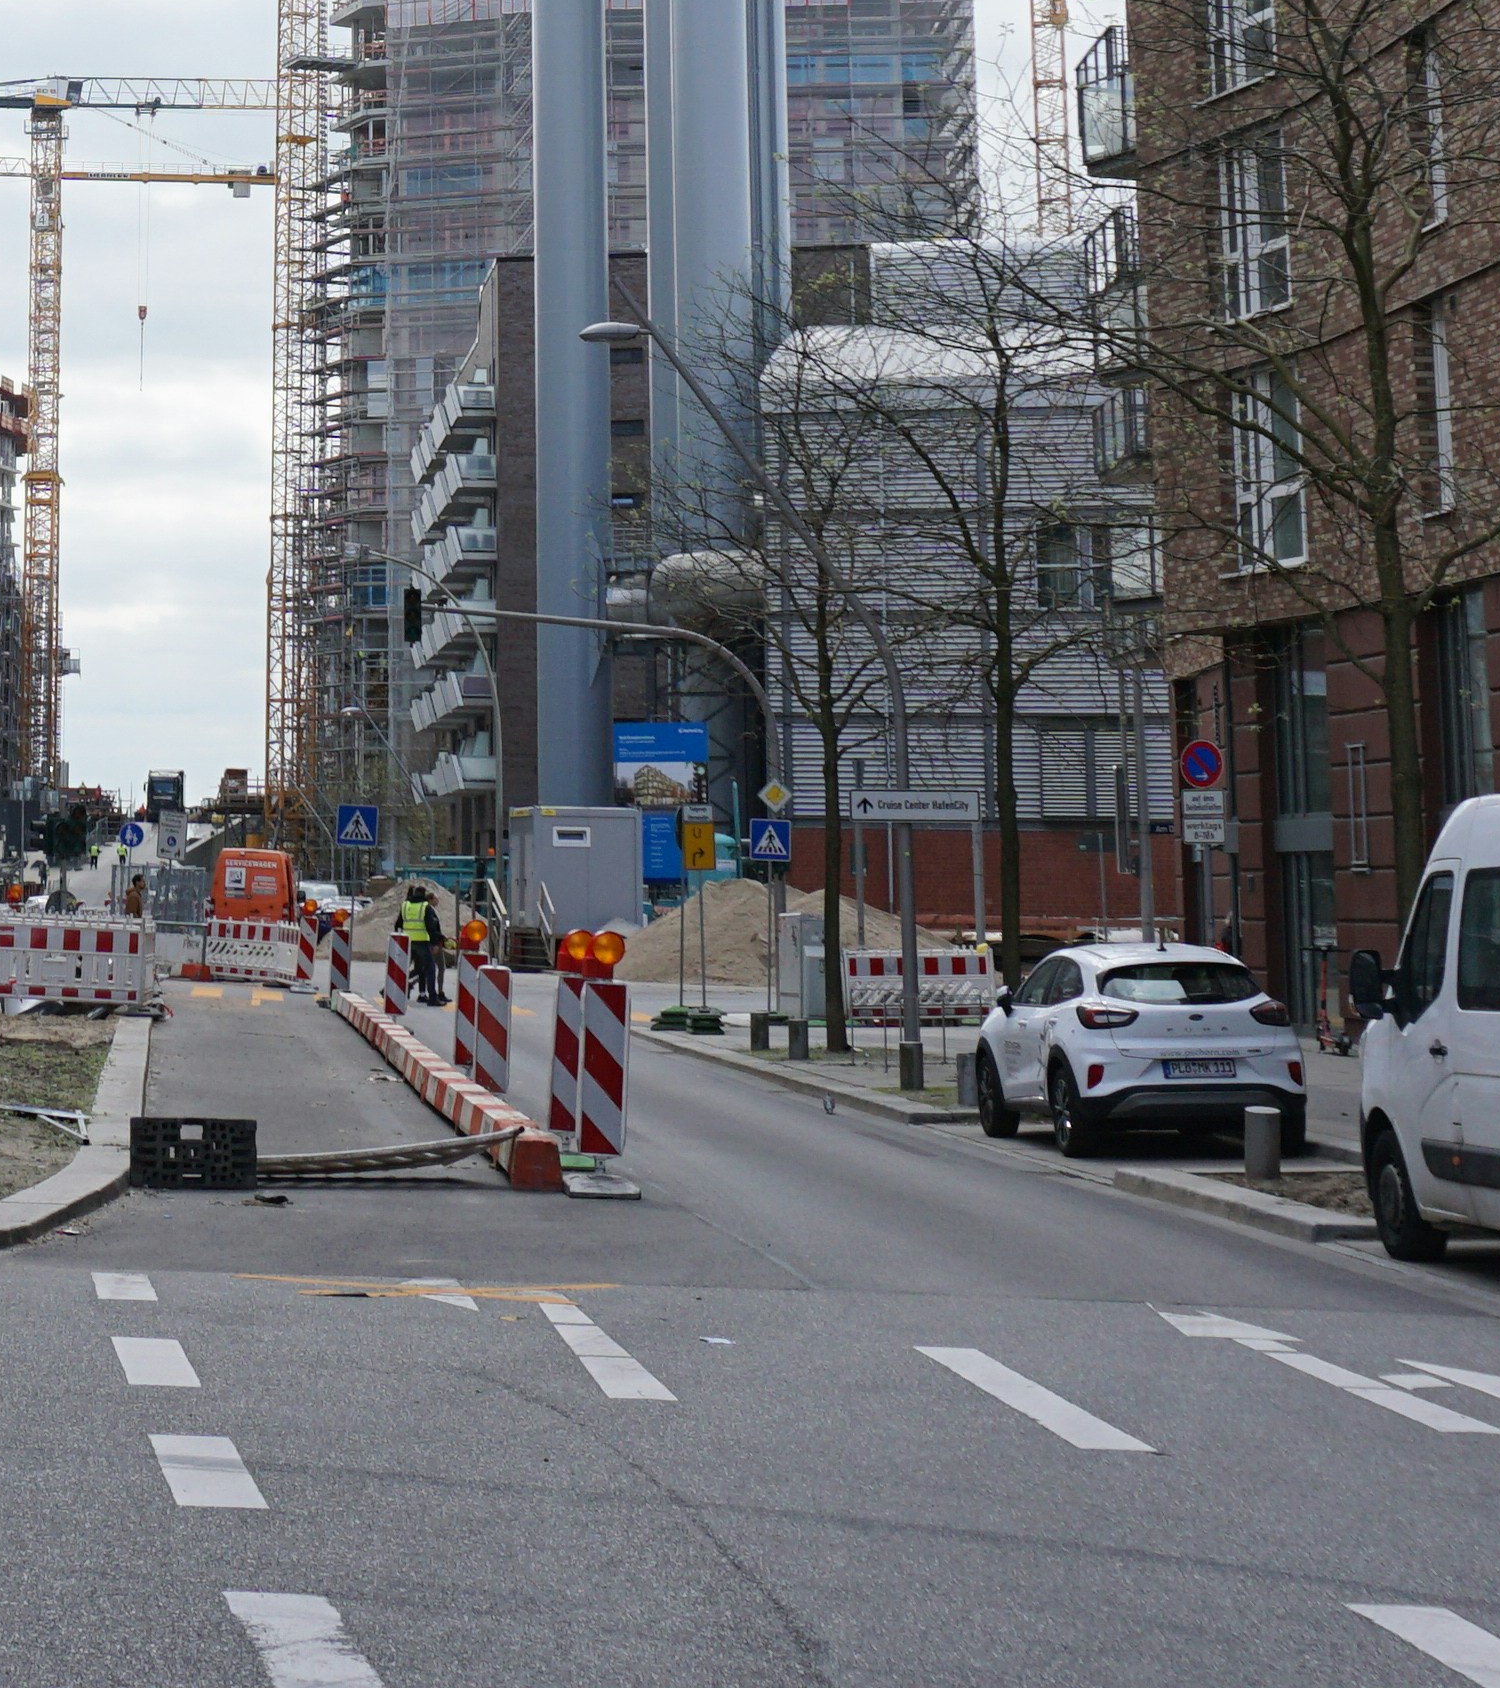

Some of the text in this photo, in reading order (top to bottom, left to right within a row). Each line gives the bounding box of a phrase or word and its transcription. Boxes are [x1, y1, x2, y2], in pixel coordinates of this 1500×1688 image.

[877, 800, 969, 812] Cruise Center HafenCity
[1186, 821, 1222, 831] werktags
[225, 859, 278, 868] SERVICEWAGEN
